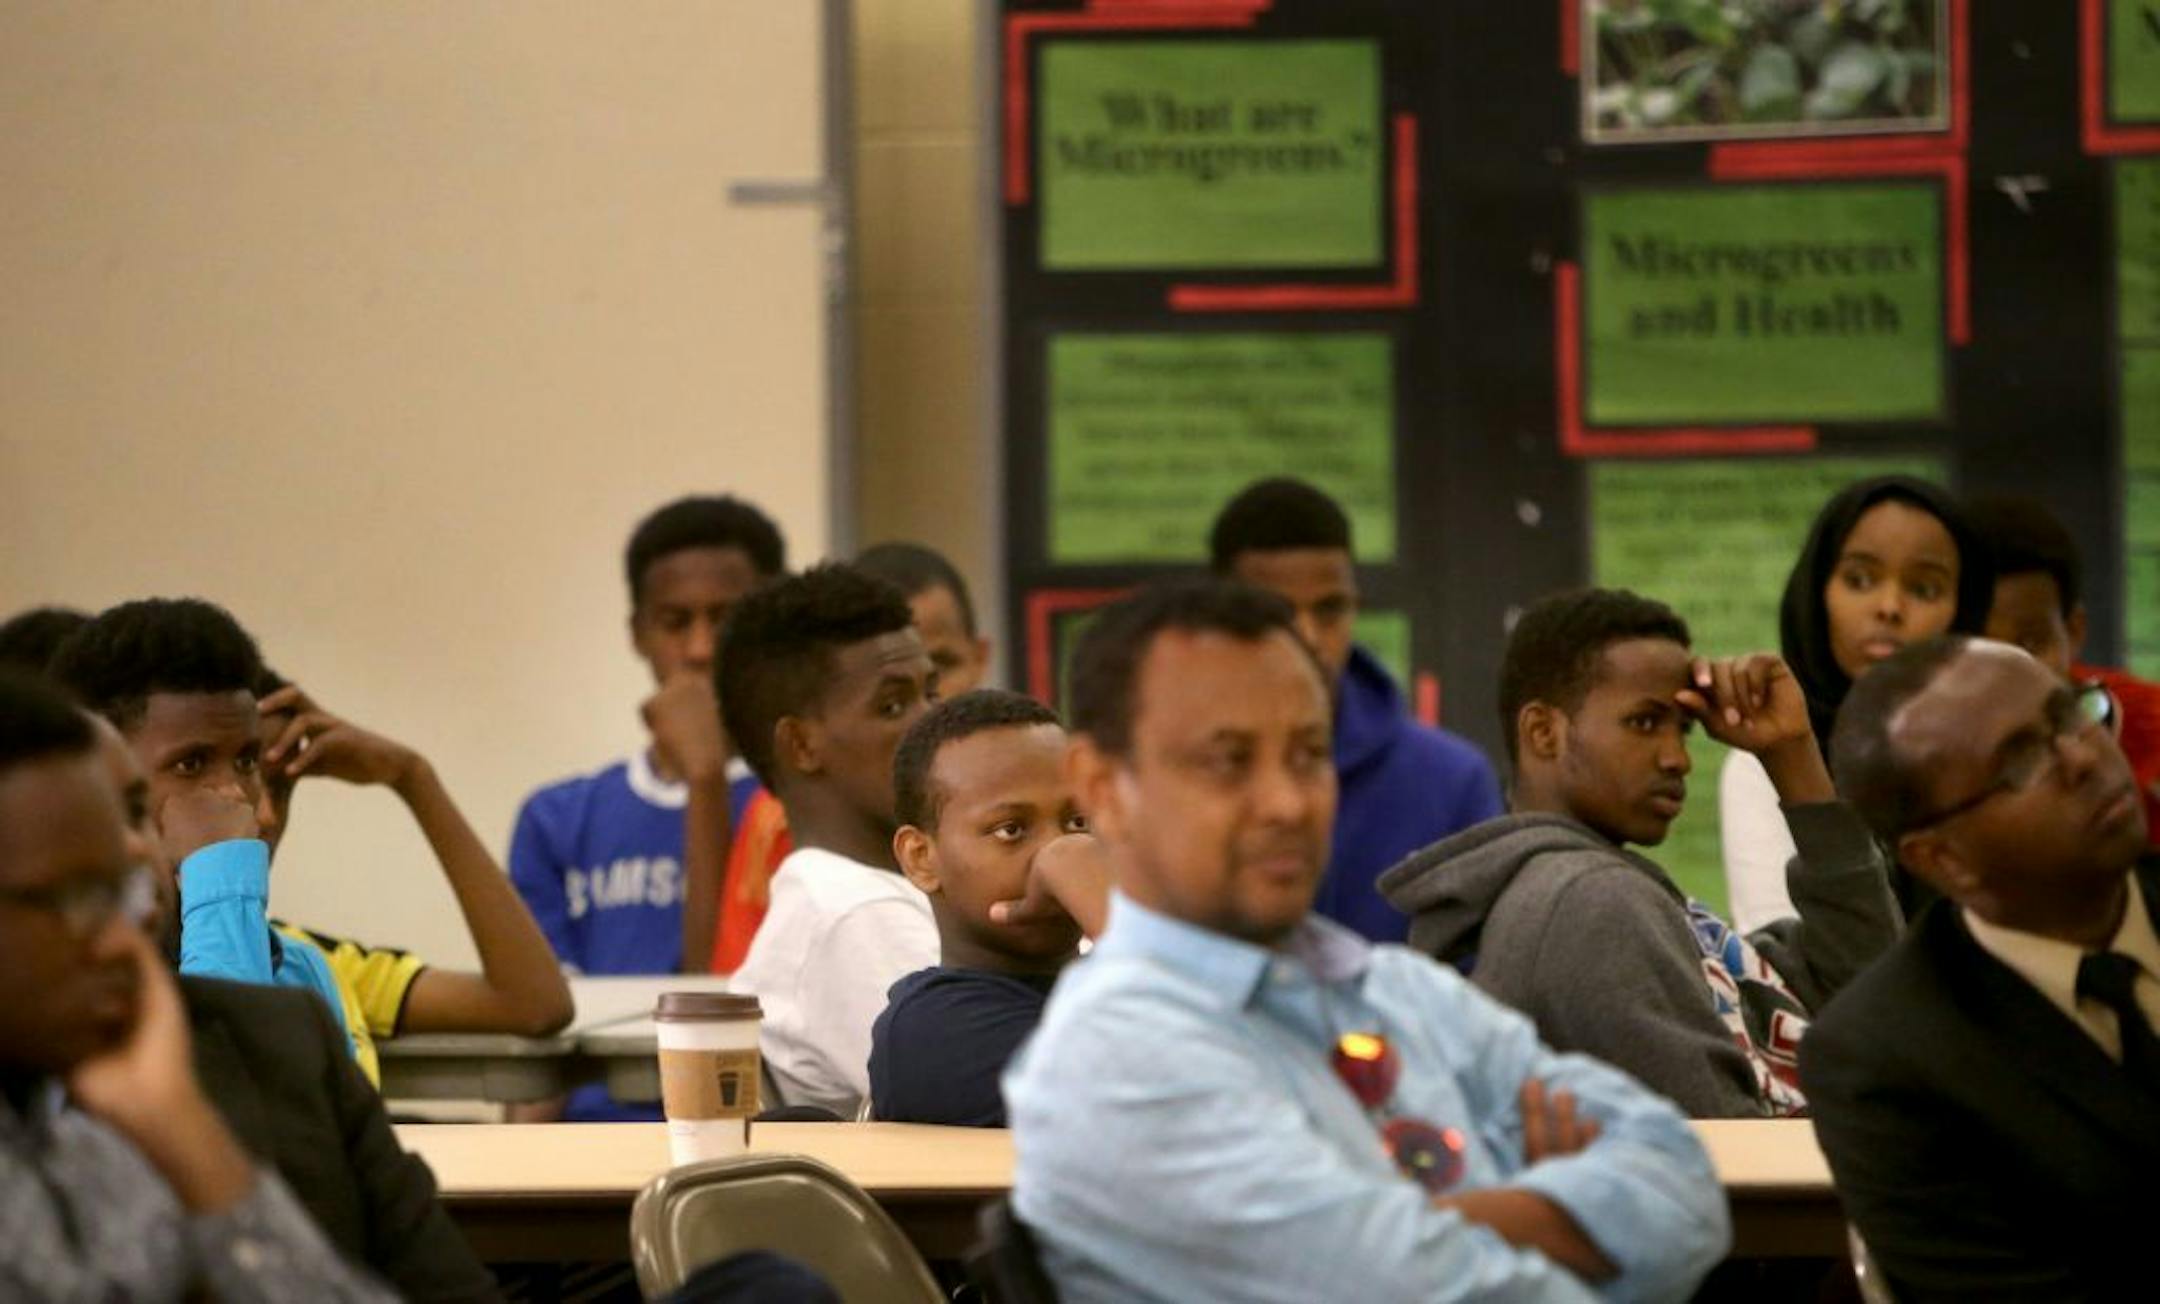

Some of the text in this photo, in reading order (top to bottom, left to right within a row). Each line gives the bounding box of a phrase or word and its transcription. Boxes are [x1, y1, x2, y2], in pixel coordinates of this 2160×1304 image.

[1102, 91, 1318, 133] What are
[1610, 232, 1918, 284] Microgreens
[1629, 290, 1903, 338] and Health
[565, 855, 690, 919] SAMS
